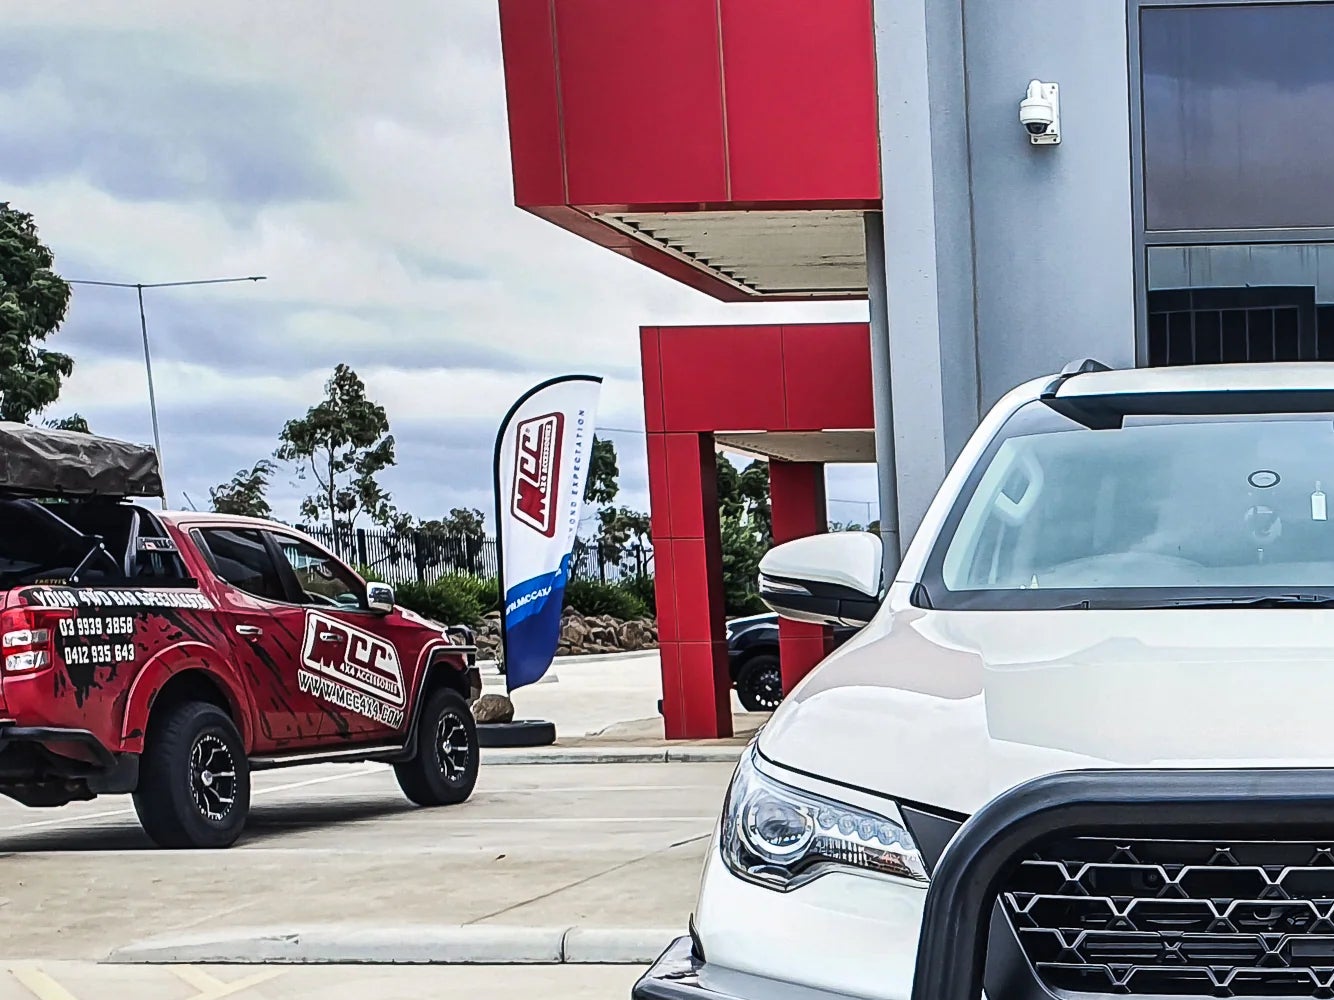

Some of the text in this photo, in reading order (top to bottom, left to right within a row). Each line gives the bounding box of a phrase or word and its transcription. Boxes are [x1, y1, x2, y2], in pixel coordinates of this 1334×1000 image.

[517, 424, 546, 528] MCC
[572, 409, 585, 496] EXPECTATION
[33, 590, 216, 611] YOUR 4WD BAR SPECIALISTS
[59, 616, 133, 637] 03 9939 3858
[64, 643, 135, 665] 0412 935 643
[307, 619, 399, 674] MCC
[298, 668, 404, 730] WWW.MCC4X4.COM
